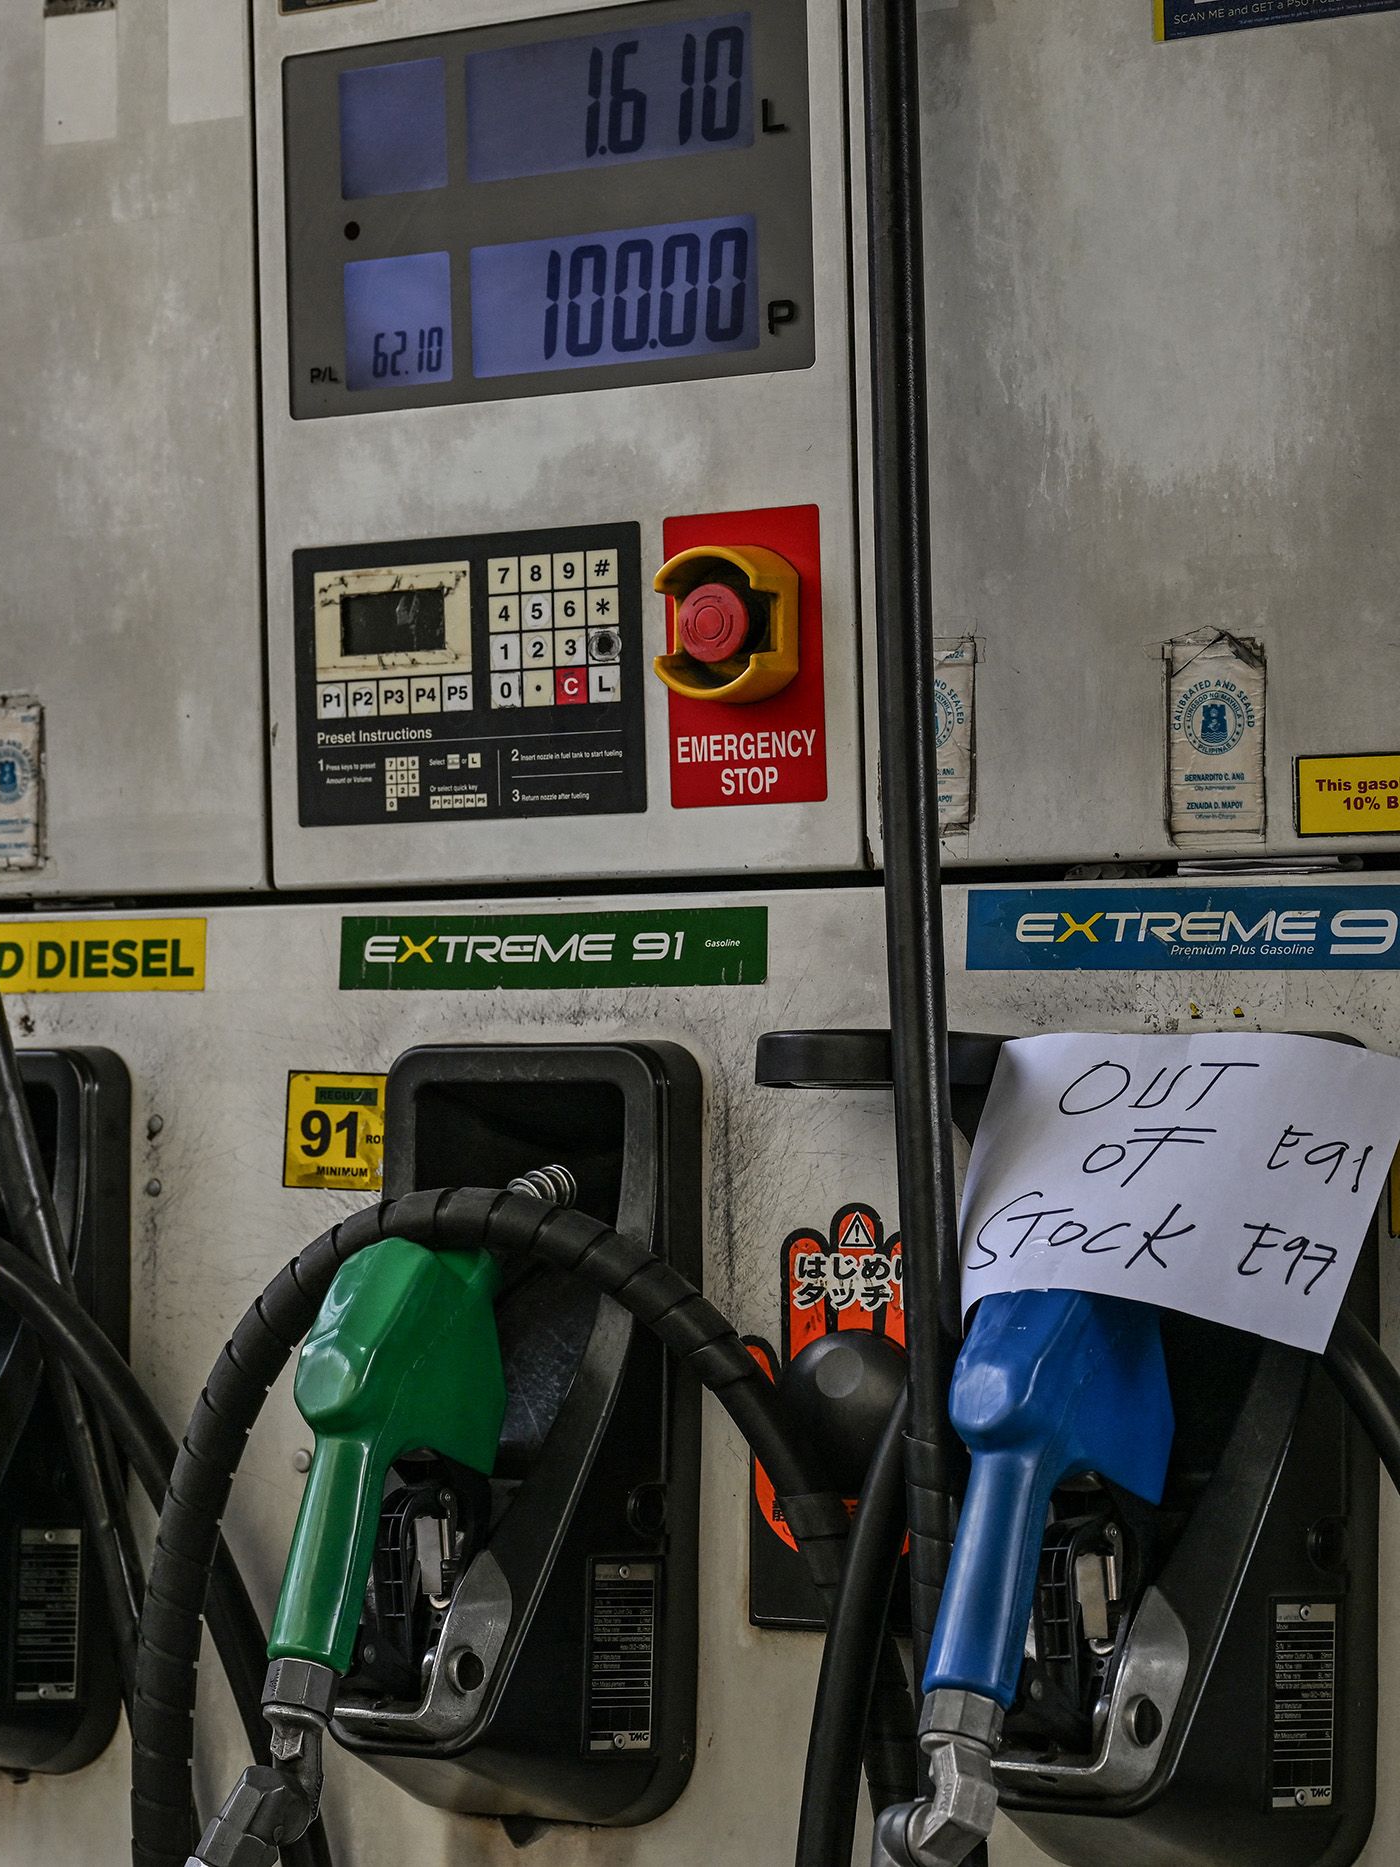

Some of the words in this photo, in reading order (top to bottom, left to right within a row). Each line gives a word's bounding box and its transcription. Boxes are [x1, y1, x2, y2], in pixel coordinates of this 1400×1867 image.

[1173, 11, 1205, 25] SCAN
[1208, 8, 1225, 20] ME
[1228, 5, 1248, 17] and
[1251, 2, 1275, 13] GET
[1276, 2, 1284, 10] a
[585, 26, 745, 158] 1.610
[761, 97, 786, 133] L
[543, 227, 749, 361] 100.00
[767, 299, 797, 336] P
[309, 365, 339, 384] P/L
[372, 326, 444, 379] 62.10
[497, 567, 510, 584] 7
[530, 565, 542, 582] 8
[563, 562, 575, 579] 9
[498, 605, 511, 622] 4
[531, 603, 543, 620] 5
[564, 600, 576, 617] 6
[500, 643, 510, 660] 1
[532, 641, 545, 658] 2
[565, 639, 577, 656] 3
[322, 692, 342, 709] P1
[352, 691, 373, 707] P2
[383, 689, 405, 705] P3
[415, 688, 436, 703] P4
[447, 686, 469, 701] P5
[500, 682, 512, 699] 0
[564, 677, 579, 696] C
[598, 676, 611, 693] L
[935, 679, 947, 691] ND
[947, 688, 965, 725] SEALED
[1173, 680, 1211, 731] CALIBRATED
[1214, 679, 1237, 693] AND
[1237, 690, 1255, 729] SEALED
[317, 731, 356, 745] Preset
[359, 727, 433, 743] Instructions
[677, 729, 816, 763] EMERGENCY
[317, 759, 325, 772] 1
[429, 758, 445, 767] Select
[511, 748, 520, 762] 2
[520, 753, 536, 761] Insert
[536, 752, 554, 760] nozzle
[561, 751, 571, 759] fuel
[591, 750, 603, 758] start
[604, 749, 623, 759] fueling
[429, 784, 437, 792] Or
[437, 784, 453, 792] select
[454, 783, 467, 793] quick
[468, 783, 479, 793] key
[720, 766, 779, 796] STOP
[1184, 773, 1224, 782] BERNARDITO
[1315, 778, 1352, 792] This
[1357, 777, 1400, 794] gaso
[511, 788, 521, 802] 3
[521, 793, 539, 802] Return
[540, 793, 557, 801] nozzle
[558, 792, 570, 800] after
[571, 791, 590, 801] fueling
[1186, 801, 1212, 810] ZENAIDA
[1343, 795, 1381, 811] 10%
[1015, 909, 1321, 943] EXTREME
[1329, 908, 1399, 955] 9
[364, 933, 616, 963] EXTREME
[632, 931, 685, 961] 91
[704, 938, 741, 948] Gasoline
[1170, 944, 1226, 956] Premium
[1230, 944, 1256, 955] Plus
[1260, 943, 1315, 956] Gasoline
[36, 939, 194, 979] DIESEL
[1058, 1060, 1260, 1116] OUT
[300, 1110, 359, 1159] 91
[365, 1134, 384, 1145] RO
[1081, 1126, 1217, 1188] OF
[316, 1166, 368, 1177] MINIMUM
[967, 1191, 1196, 1270] STOCK
[1237, 1222, 1338, 1295] E97
[629, 1732, 649, 1742] TMG
